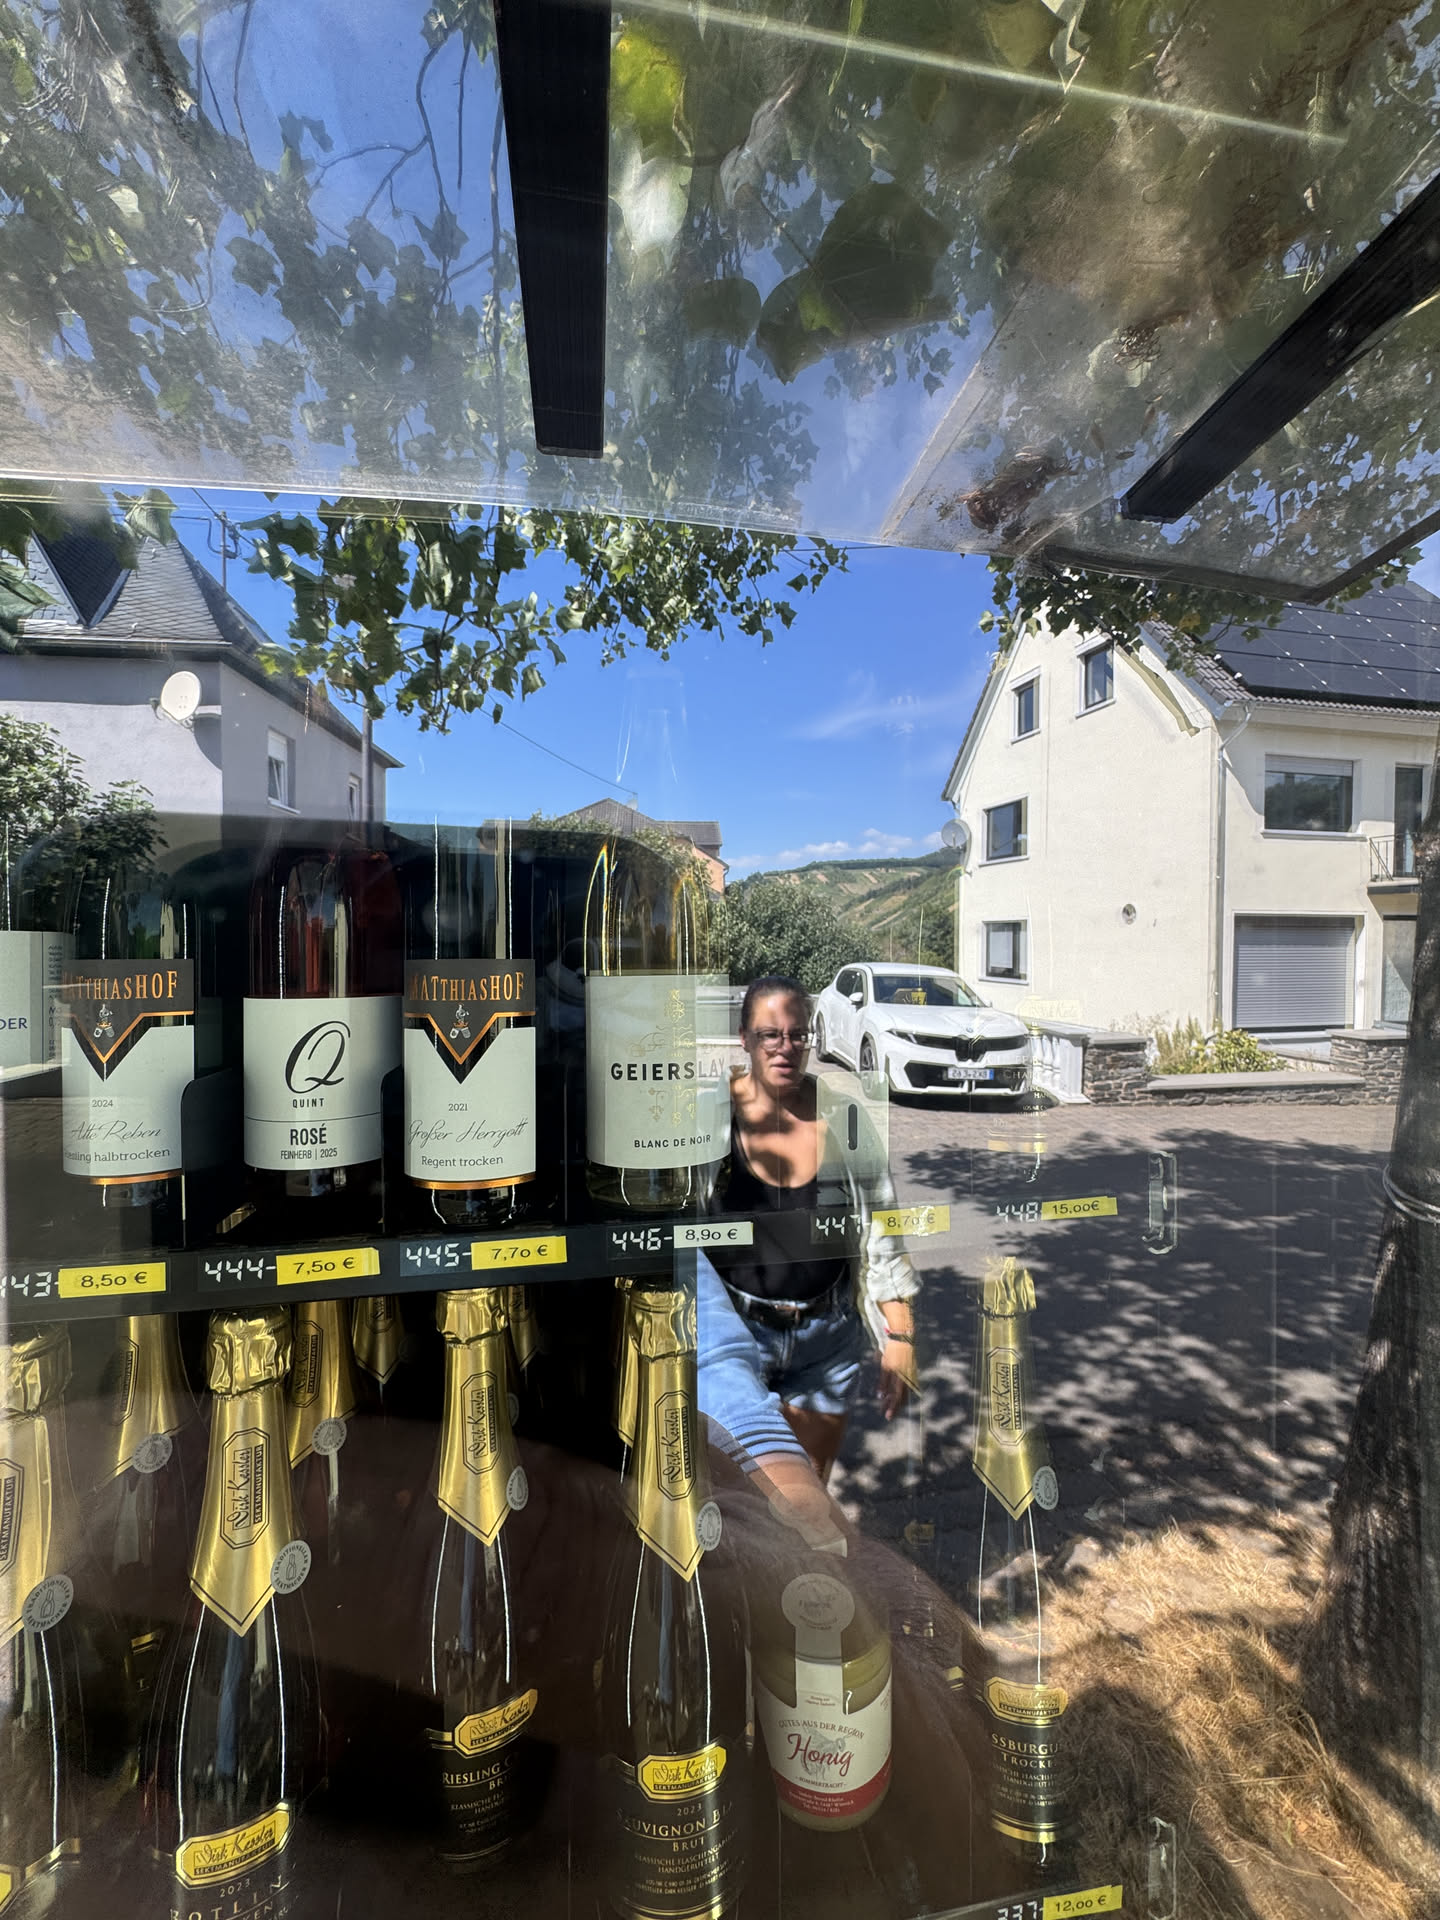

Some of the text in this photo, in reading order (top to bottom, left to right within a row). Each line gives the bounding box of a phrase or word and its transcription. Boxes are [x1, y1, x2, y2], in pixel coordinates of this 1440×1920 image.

[285, 1020, 351, 1094] Q
[611, 1058, 725, 1081] GEIERSLAY
[92, 1099, 114, 1108] 2024
[292, 1097, 325, 1109] QUINT
[448, 1103, 468, 1112] 2021
[71, 1119, 162, 1143] Alte Reben
[289, 1123, 327, 1146] ROSÉ
[408, 1117, 529, 1149] Großer Herrgott
[634, 1134, 711, 1149] BLANC DE NOIR
[94, 1147, 171, 1163] halbtrocken
[280, 1149, 312, 1161] FEINHERB
[319, 1147, 338, 1159] 2025
[421, 1155, 504, 1169] Regent trocken
[685, 1228, 722, 1242] 8,90
[727, 1228, 738, 1240] €
[491, 1247, 531, 1261] 7,70
[537, 1244, 548, 1257] €
[293, 1260, 336, 1275] 7,50
[342, 1257, 355, 1270] €
[80, 1274, 127, 1289] 8,50
[134, 1271, 148, 1285] €
[227, 1450, 250, 1491] Kessler
[254, 1444, 264, 1524] SEKTMANUFAKTUR
[0, 1477, 15, 1561] SEKTMANUFAKTUR
[778, 1719, 865, 1740] GUTES AUS DER REGION
[991, 1732, 1059, 1756] SSBURGU
[786, 1732, 855, 1778] Honig
[442, 1762, 501, 1786] RIESLING
[676, 1803, 703, 1817] 2023
[672, 1836, 704, 1853] BRUT
[219, 1878, 250, 1898] 2023
[1055, 1900, 1094, 1913] 12,00
[1097, 1894, 1107, 1906] €
